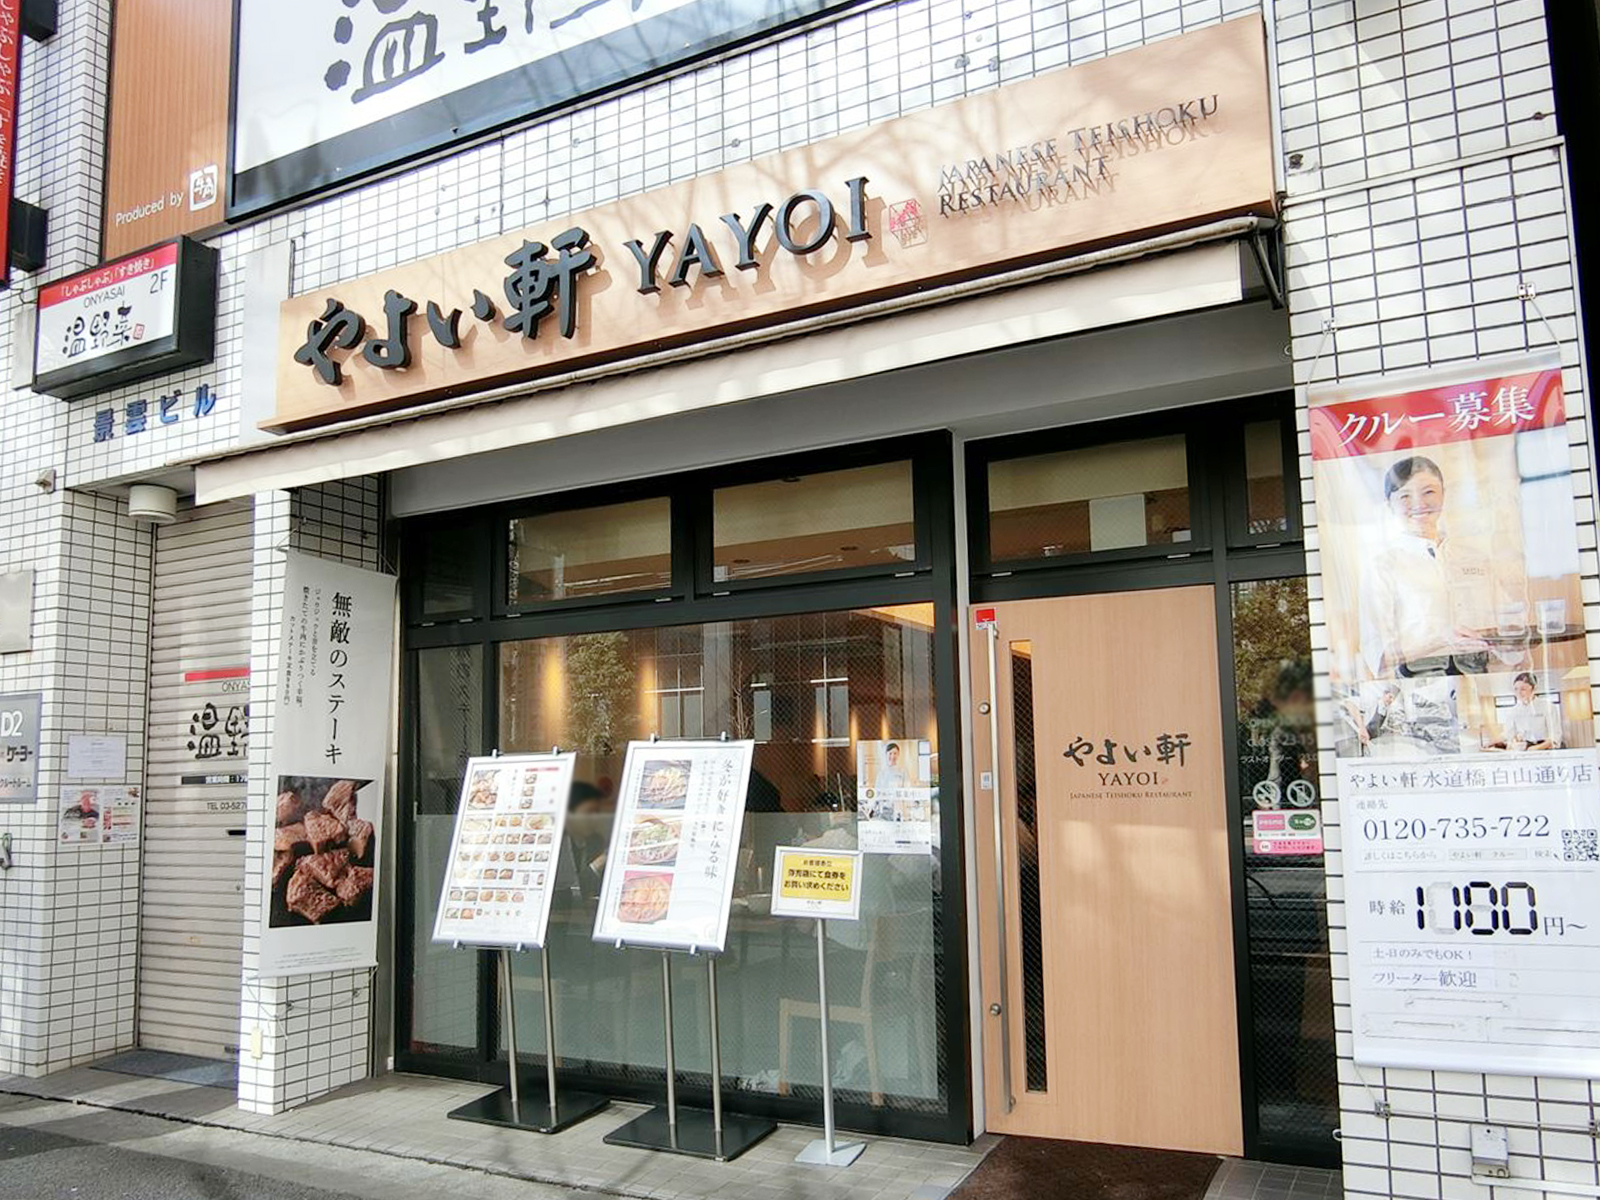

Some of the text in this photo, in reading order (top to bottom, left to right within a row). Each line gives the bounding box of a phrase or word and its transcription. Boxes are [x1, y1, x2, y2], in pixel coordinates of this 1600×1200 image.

[1068, 94, 1218, 150] TEISHOKU
[938, 156, 1109, 215] RESTAURANT
[116, 191, 184, 228] Produced by
[624, 175, 872, 295] YAYOI
[84, 285, 125, 308] ONYASAI
[150, 269, 168, 294] 2F
[294, 226, 597, 386] やよい軒
[1337, 384, 1536, 448] クルー募集
[325, 592, 353, 764] 無敵のステーキ
[1063, 733, 1192, 767] やよい軒
[1098, 771, 1158, 786] YAYOI
[1363, 814, 1551, 841] 0120-735-722
[1369, 899, 1406, 915] 時給
[1372, 969, 1477, 989] フリーター歓迎
